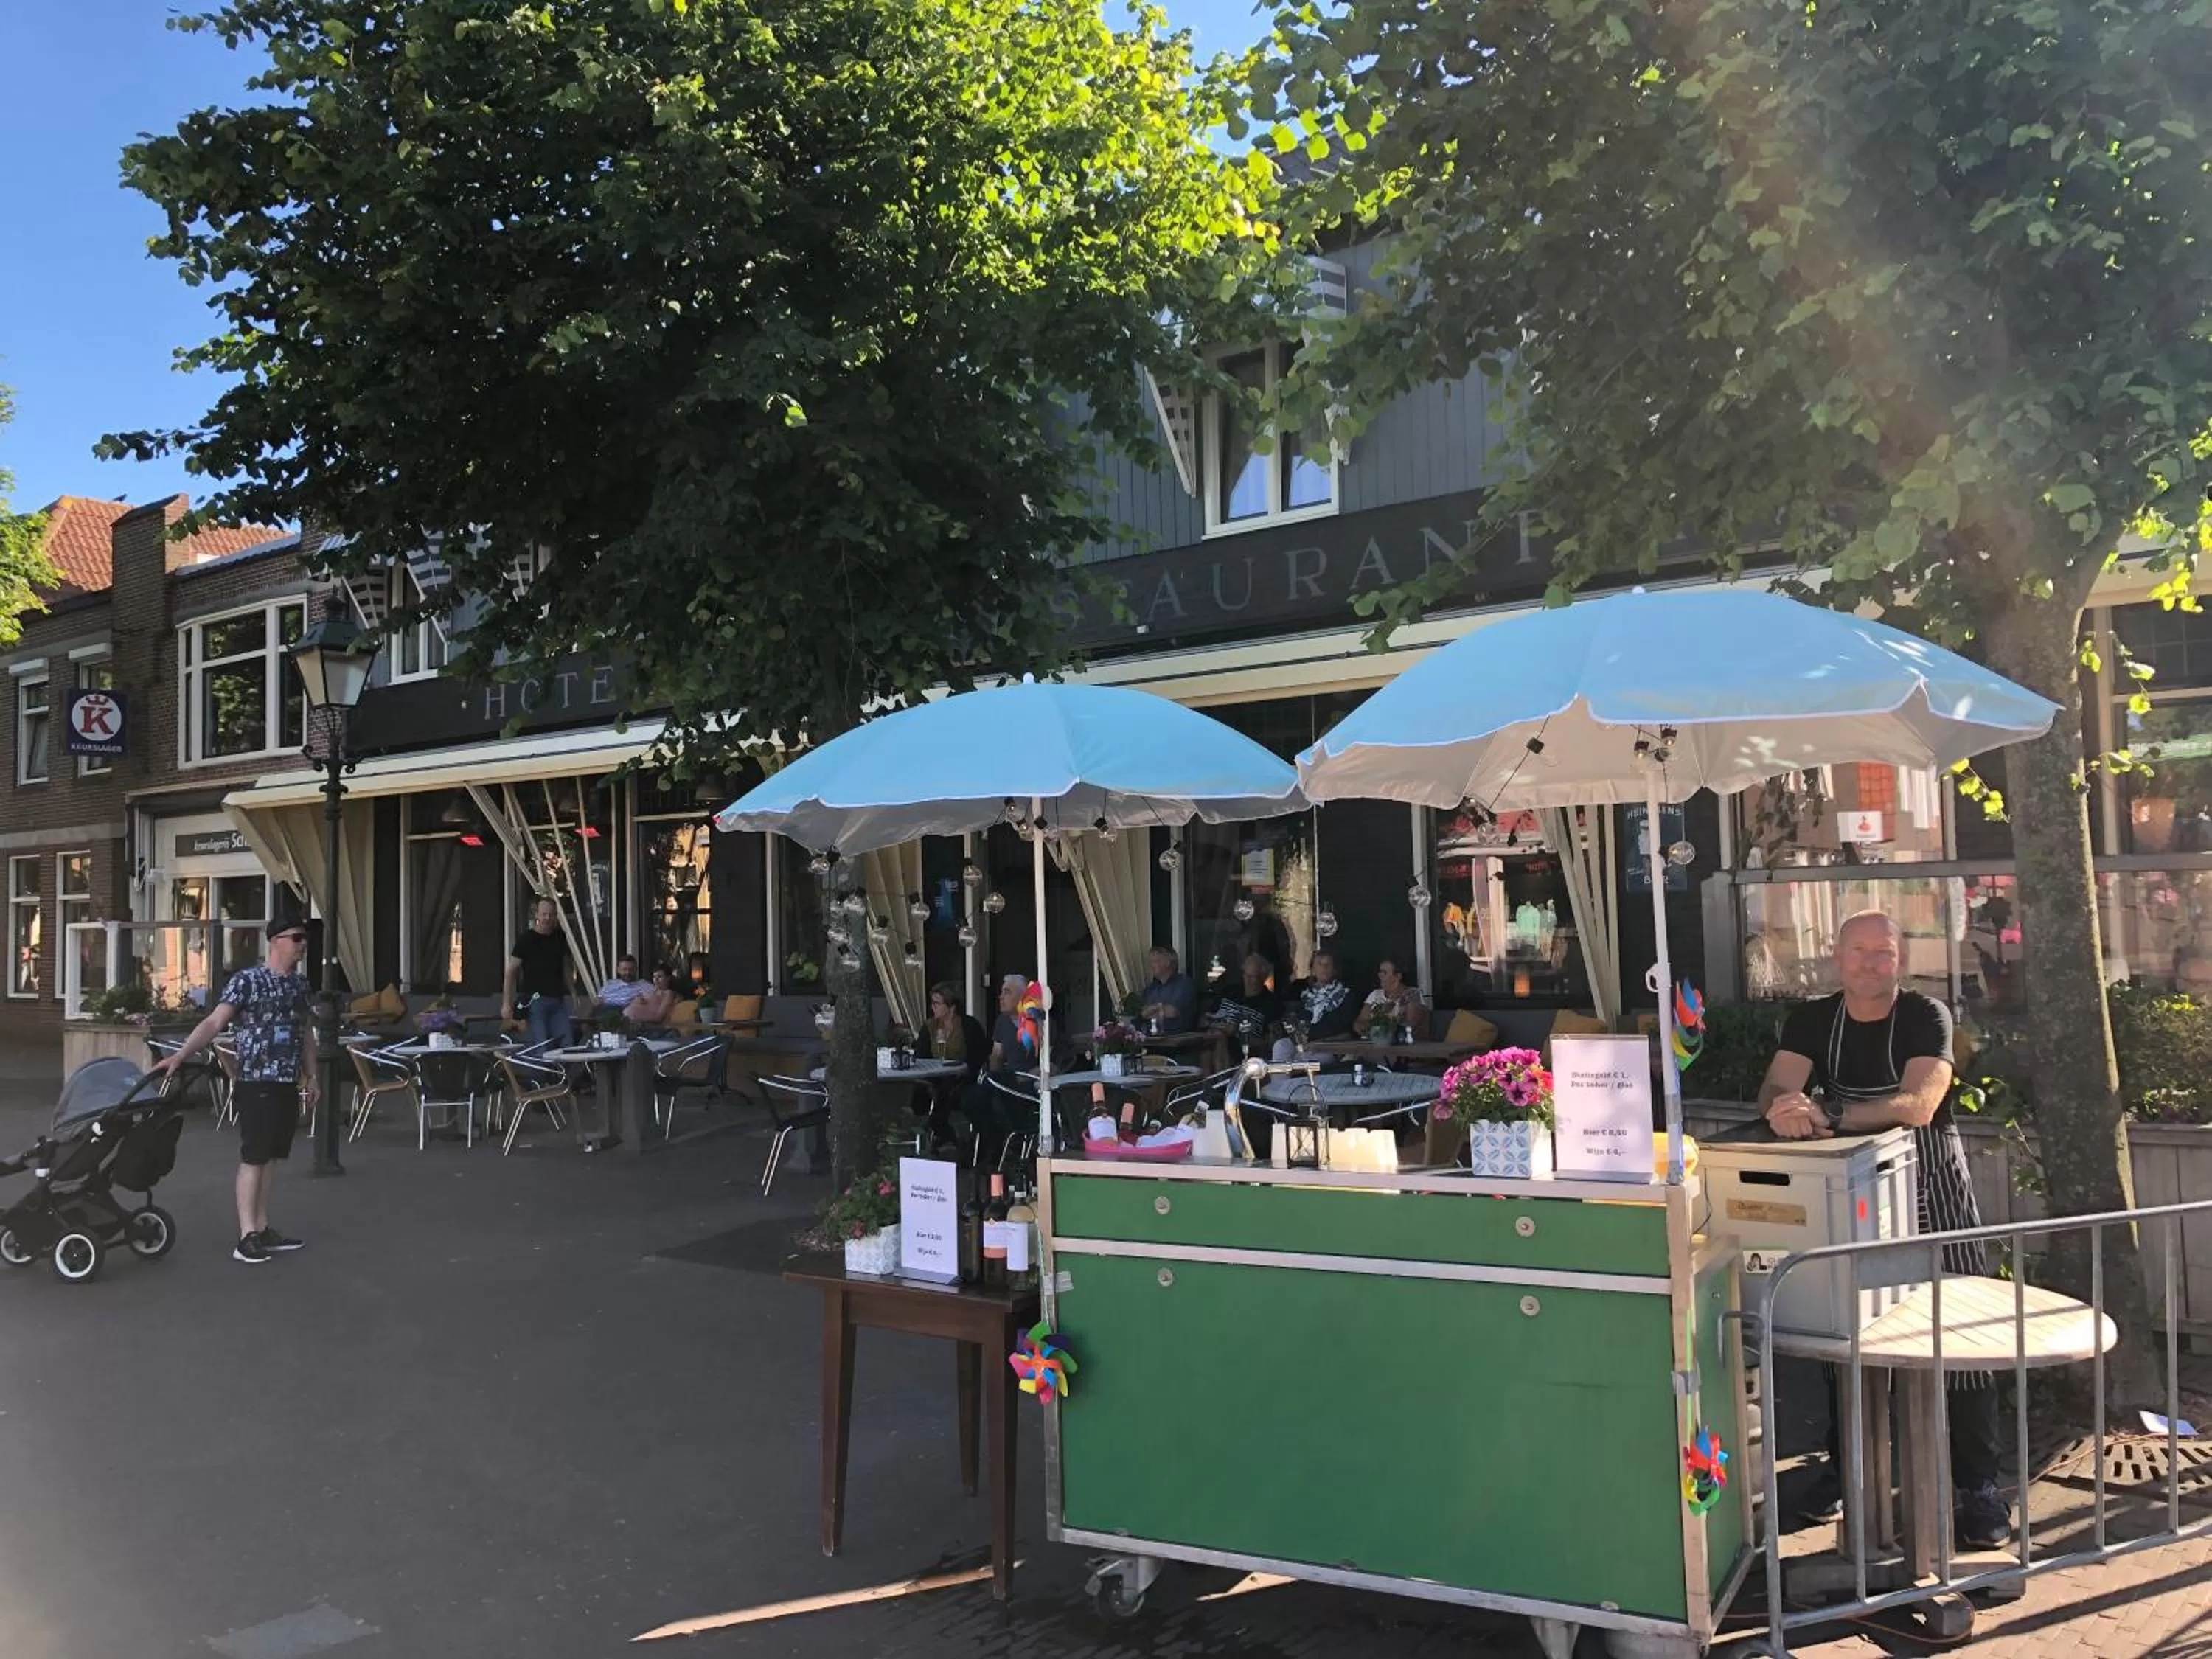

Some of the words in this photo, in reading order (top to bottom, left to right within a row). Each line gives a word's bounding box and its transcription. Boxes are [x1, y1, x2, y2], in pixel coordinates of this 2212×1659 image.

[483, 665, 616, 720] HOTE
[80, 706, 114, 734] K
[1627, 806, 1683, 819] HEINENS
